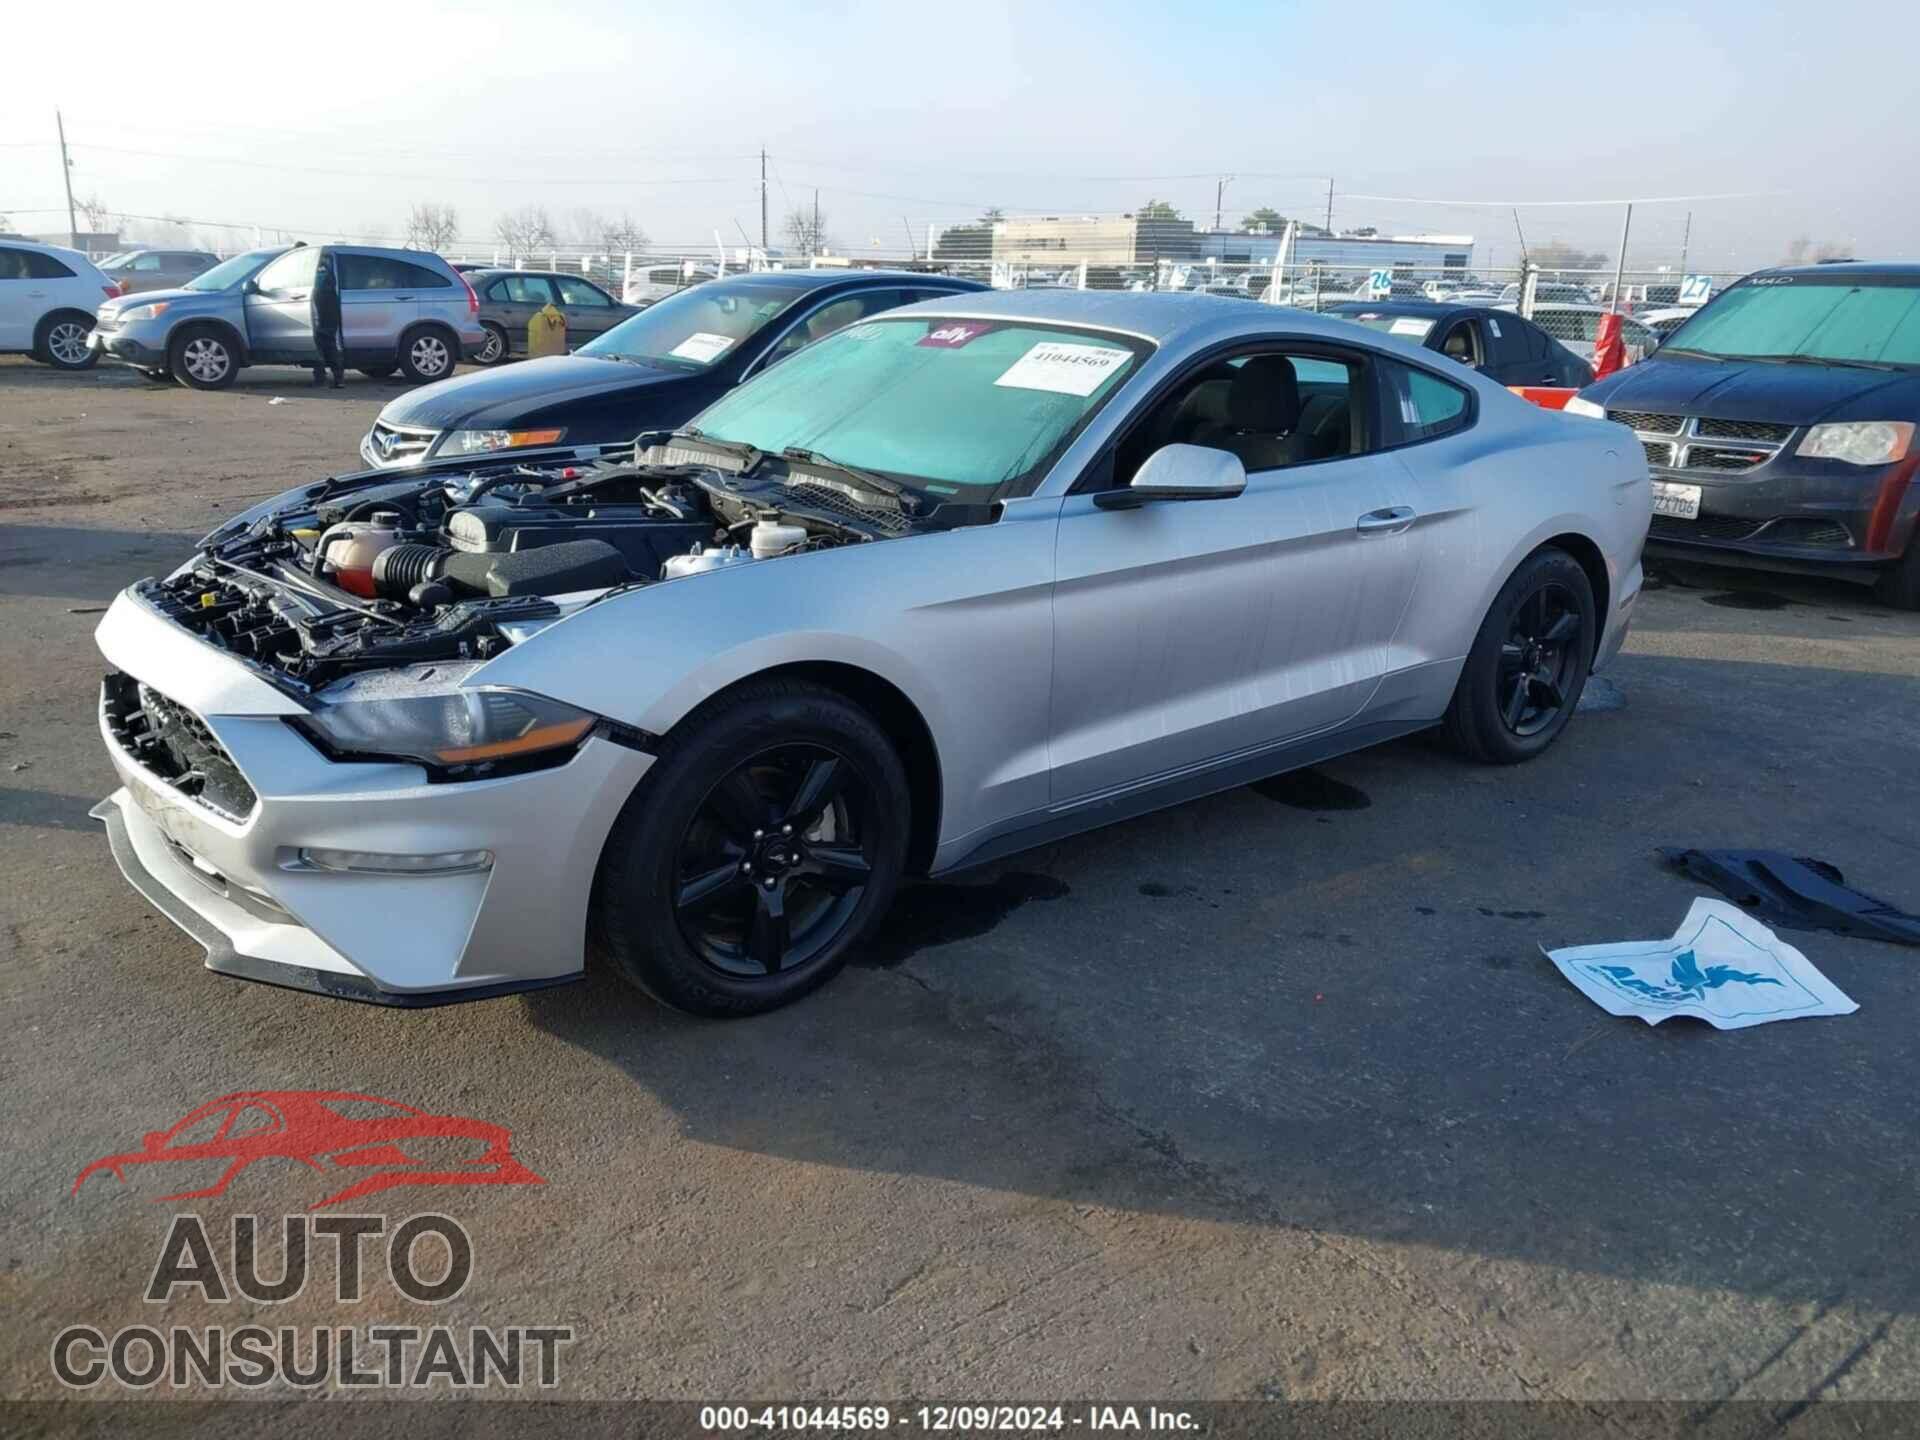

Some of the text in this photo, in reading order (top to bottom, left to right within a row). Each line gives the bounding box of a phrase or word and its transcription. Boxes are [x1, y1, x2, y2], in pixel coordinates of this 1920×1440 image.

[1371, 270, 1392, 290] 26
[1682, 276, 1711, 298] 27
[931, 326, 974, 343] ally
